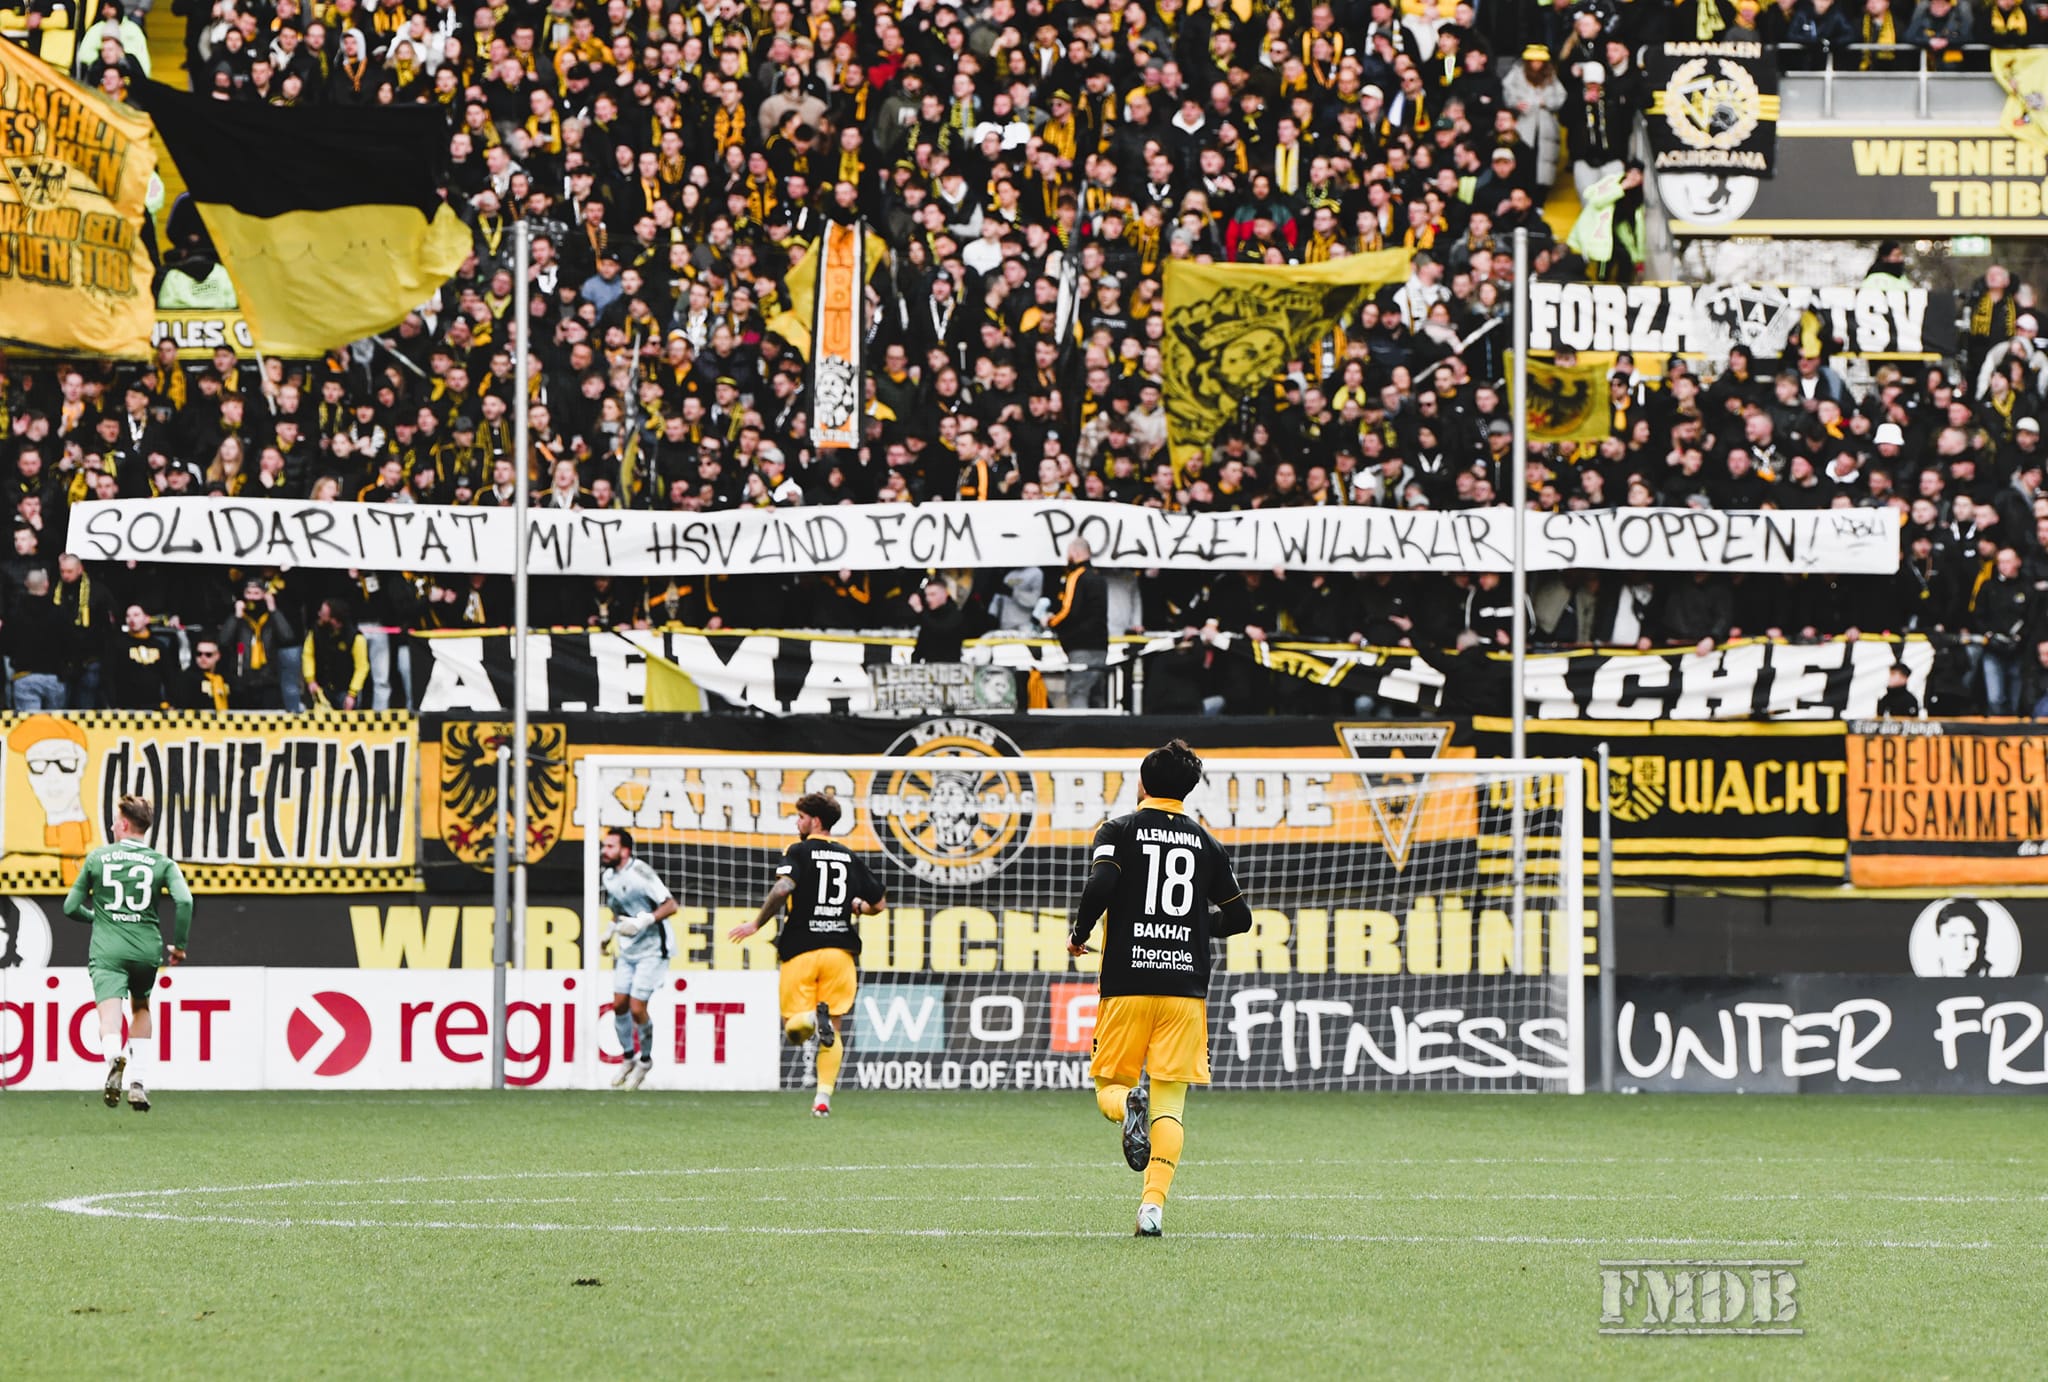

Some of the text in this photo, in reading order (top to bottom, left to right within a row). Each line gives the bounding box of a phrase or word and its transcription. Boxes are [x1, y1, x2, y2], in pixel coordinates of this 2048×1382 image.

[1930, 180, 2048, 217] TRIB
[1530, 283, 1703, 353] FORZA
[86, 506, 488, 563] SOLIDARITÄT
[526, 517, 622, 571] MIT
[646, 521, 741, 567] HSV
[751, 514, 848, 565] UND
[866, 512, 982, 563] FCM
[911, 721, 998, 746] KARLS
[103, 741, 408, 859] CONNECTION
[1668, 758, 1847, 815] WACHT
[1859, 788, 2043, 838] ZUSAMMEN
[1136, 828, 1202, 850] ALEMANNIA
[102, 863, 154, 912] 53
[816, 860, 848, 906] 13
[1142, 844, 1196, 917] 18
[1134, 922, 1192, 942] BAKHAT
[1228, 989, 2048, 1085] FITNESS UNTER FR
[857, 1060, 1096, 1090] WORLD OF FITNE
